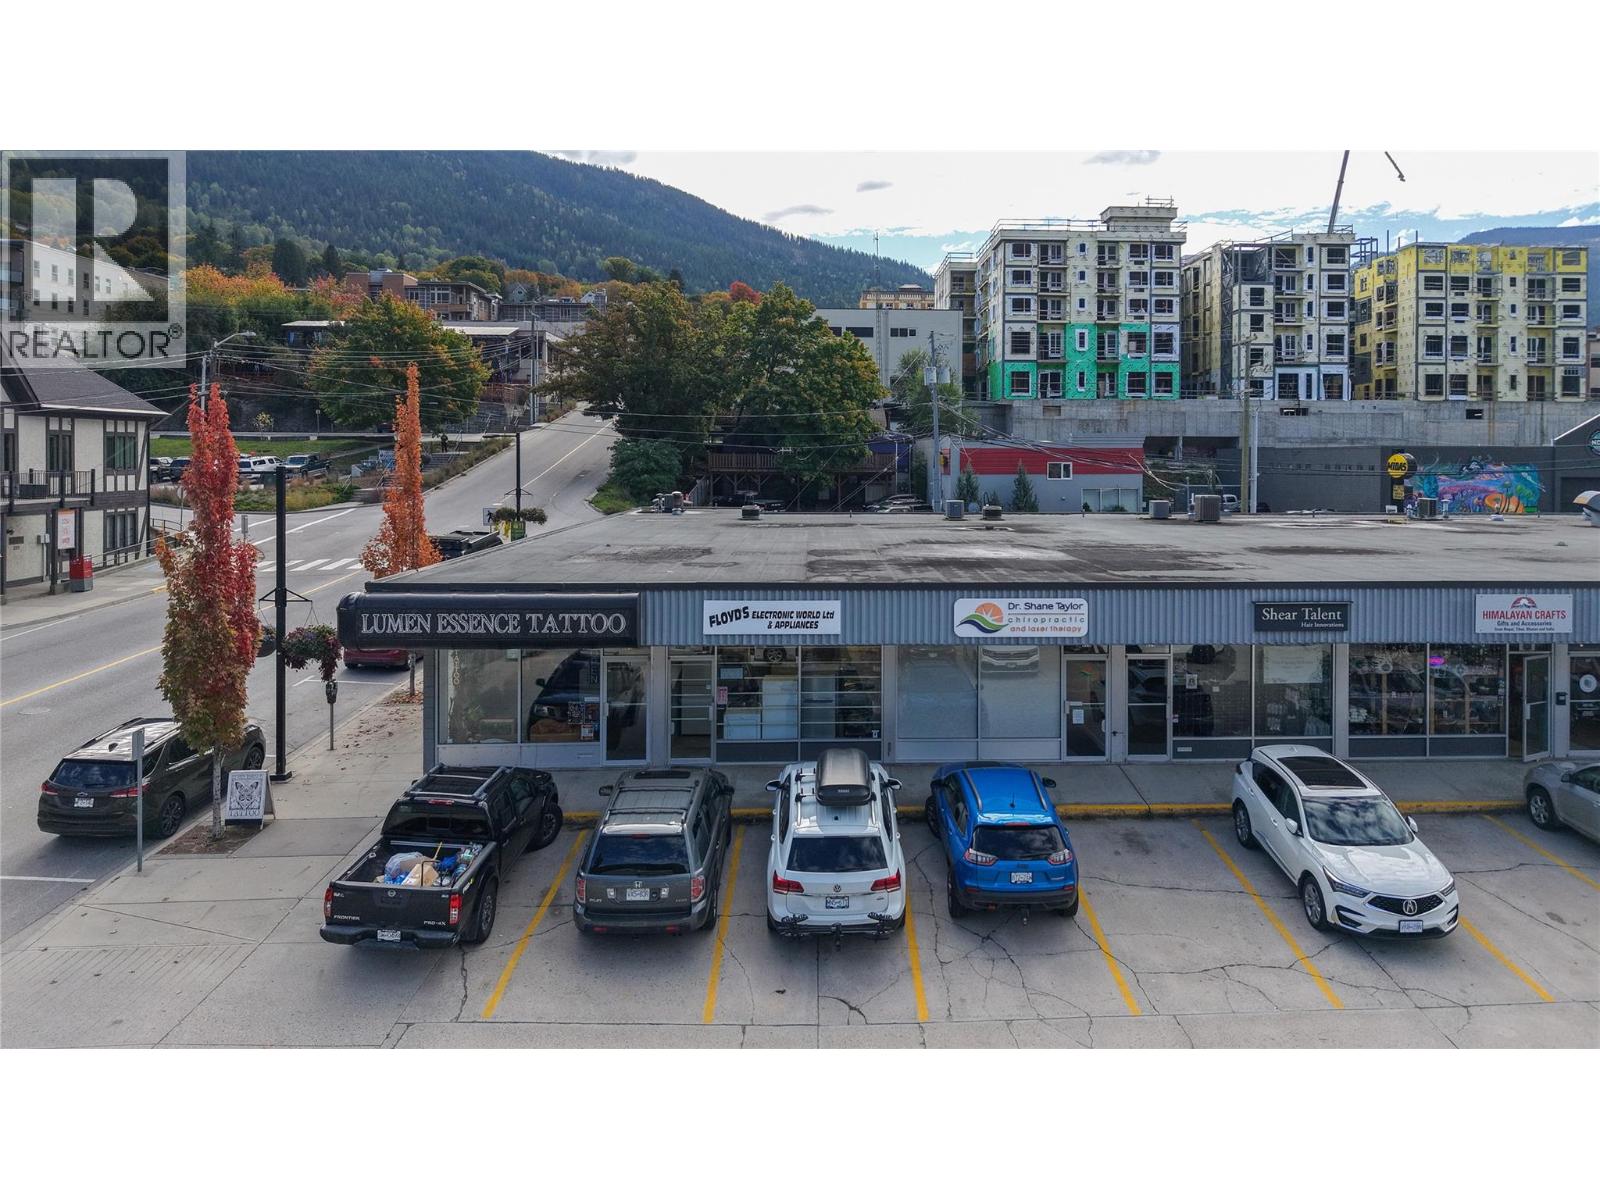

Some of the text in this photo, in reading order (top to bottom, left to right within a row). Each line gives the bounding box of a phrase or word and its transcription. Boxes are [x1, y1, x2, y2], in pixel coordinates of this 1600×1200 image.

[1008, 602, 1083, 612] Dr. Shane Taylor
[751, 611, 794, 619] ELECTRONIC
[796, 611, 820, 619] WORLD
[1262, 607, 1342, 620] Shear Talent
[1482, 610, 1566, 620] HIMALAYAN CRAFTS
[361, 613, 626, 634] LUMEN ESSENCE TATTOO
[1008, 615, 1085, 624] chiropractic
[774, 621, 819, 629] APPLIANCES
